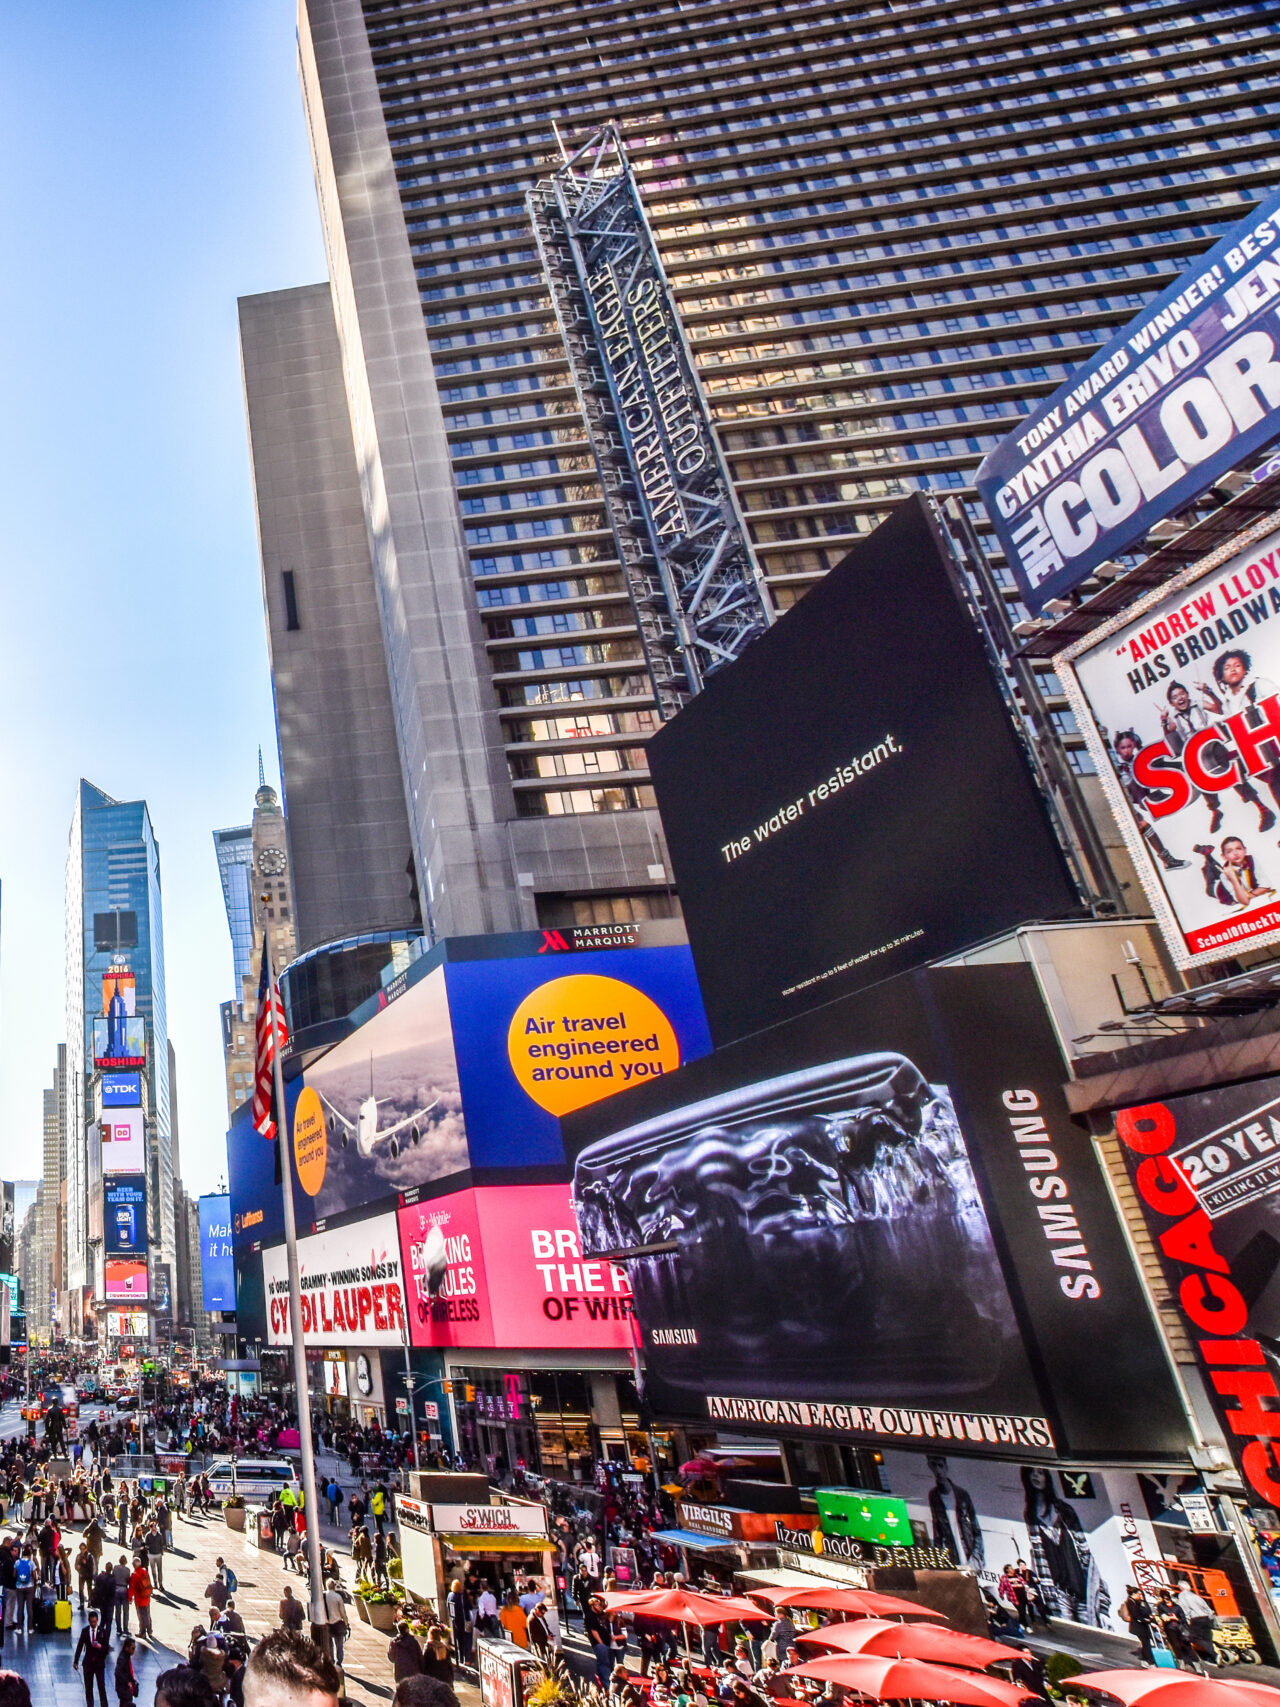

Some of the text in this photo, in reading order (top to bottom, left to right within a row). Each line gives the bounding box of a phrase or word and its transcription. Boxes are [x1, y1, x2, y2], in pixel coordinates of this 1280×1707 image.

[1016, 264, 1226, 456] TONY AWARD WINNER!
[627, 277, 709, 476] OUTFITTERS
[587, 262, 687, 538] AMERICAN EAGLE
[995, 330, 1201, 519] CYNTHIA ERIVO
[1043, 331, 1280, 559] COLOR
[1010, 506, 1065, 590] THE
[1127, 654, 1171, 694] HAS
[721, 830, 753, 863] The
[753, 798, 806, 842] water
[573, 924, 641, 937] MARRIOTT
[575, 935, 636, 948] MARQUIS
[108, 965, 129, 974] 2016
[524, 1012, 626, 1035] Air travel
[528, 1033, 660, 1060] engineered
[96, 1057, 145, 1067] TOSHIBA
[532, 1060, 663, 1082] around you
[112, 1085, 137, 1093] TDK
[297, 1127, 323, 1151] engineered
[299, 1146, 324, 1167] around you
[1182, 1145, 1231, 1186] 20
[1002, 1088, 1101, 1300] SAMSUNG
[1211, 1172, 1269, 1206] KILLING IT
[241, 1209, 264, 1229] Lufthansa
[210, 1243, 218, 1257] it
[361, 1261, 399, 1280] SONGS BY
[536, 1263, 606, 1292] THE
[320, 1282, 404, 1333] LAUPER
[418, 1299, 480, 1323] OF WIRELESS
[543, 1296, 580, 1321] OF
[1116, 1102, 1280, 1510] CHICAGO
[706, 1396, 1055, 1449] AMERICAN EAGLE OUTFITTERS
[681, 1503, 733, 1531] VIRGIL'S
[873, 1546, 958, 1569] DRINK
